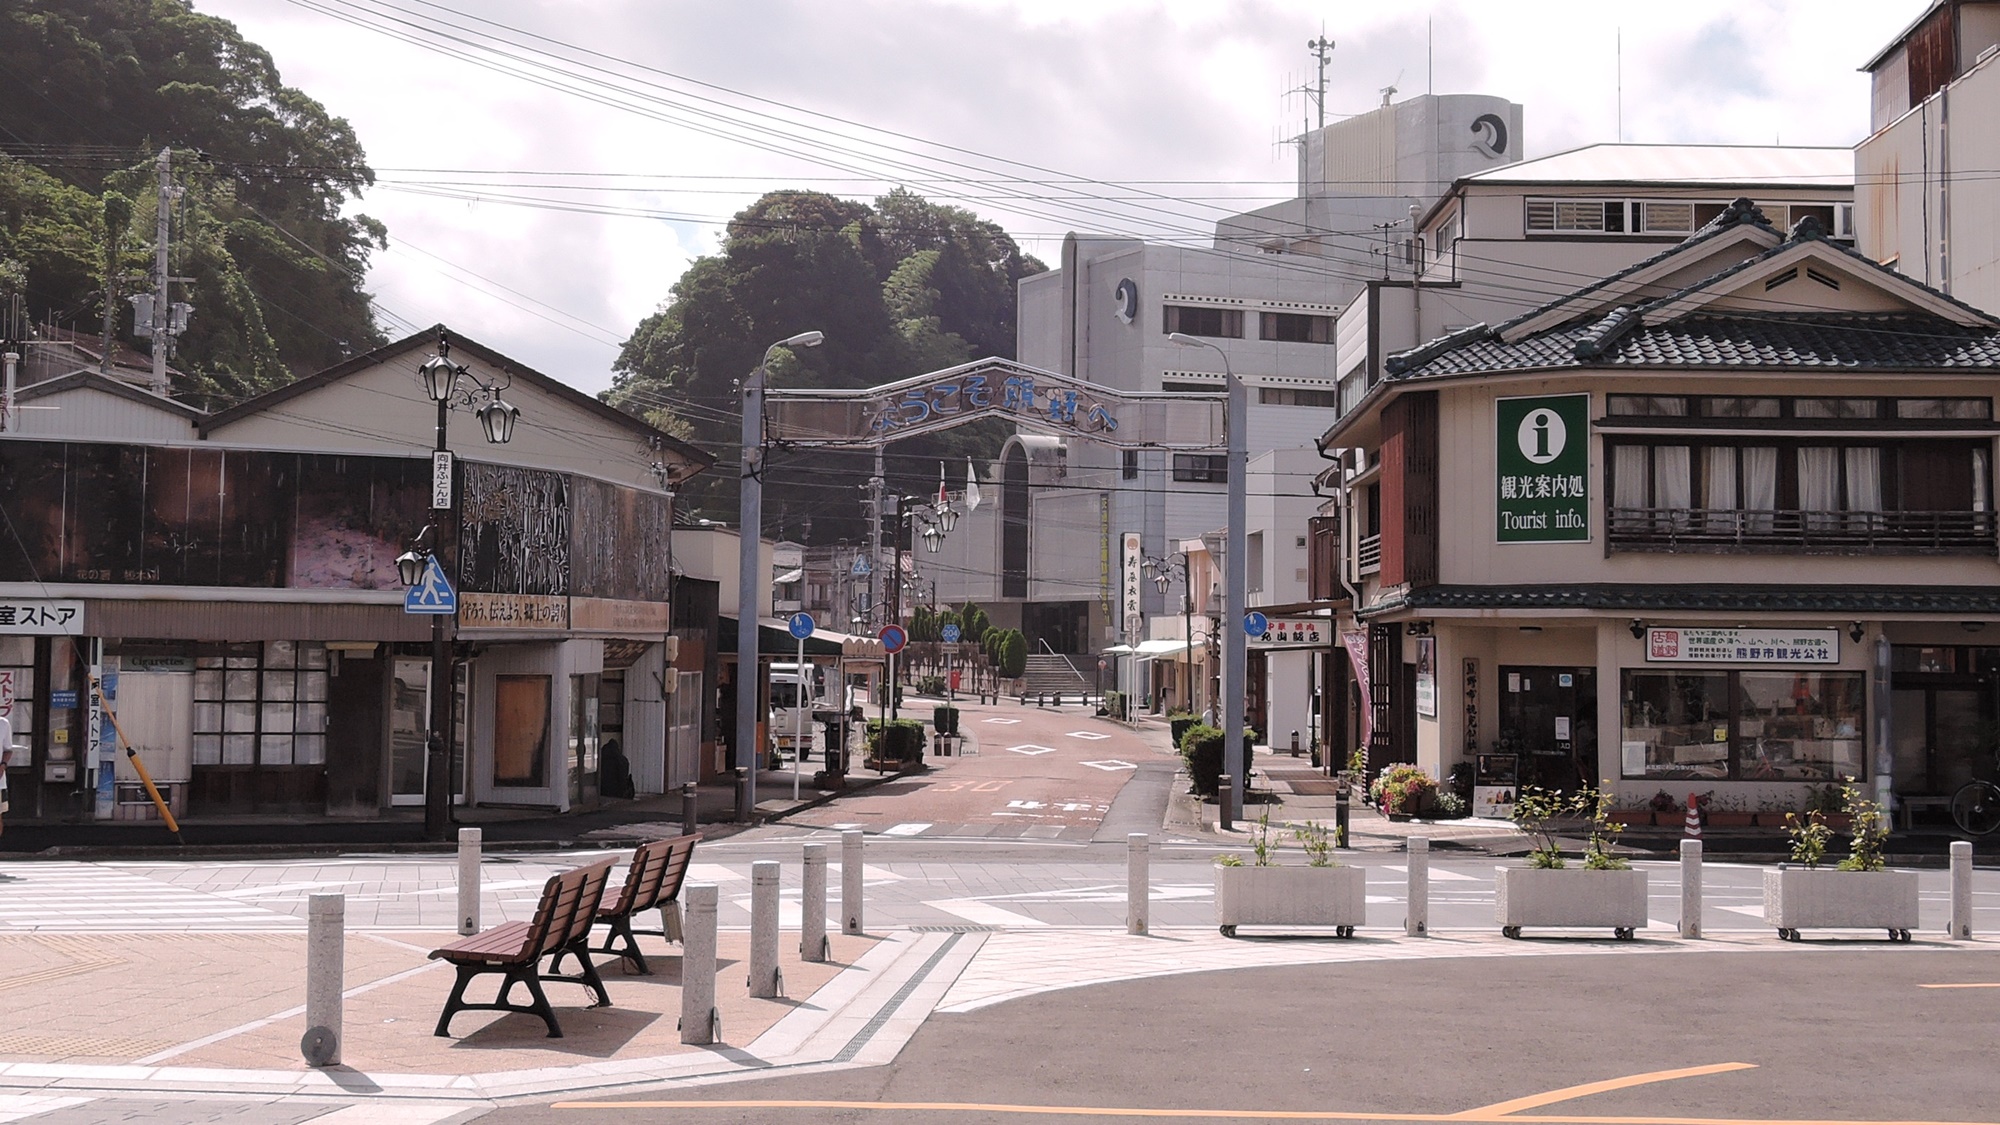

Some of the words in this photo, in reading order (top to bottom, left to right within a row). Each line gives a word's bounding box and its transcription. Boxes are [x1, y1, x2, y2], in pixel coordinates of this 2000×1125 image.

[436, 453, 449, 507] 向井ふとん店
[1501, 474, 1584, 500] 観光案内処
[1502, 510, 1547, 529] Tourist
[1556, 508, 1585, 528] info.
[0, 605, 76, 626] 室ストア
[131, 655, 185, 669] Cigarettes
[1736, 647, 1828, 660] 熊野市観光公社
[931, 780, 1014, 792] 30
